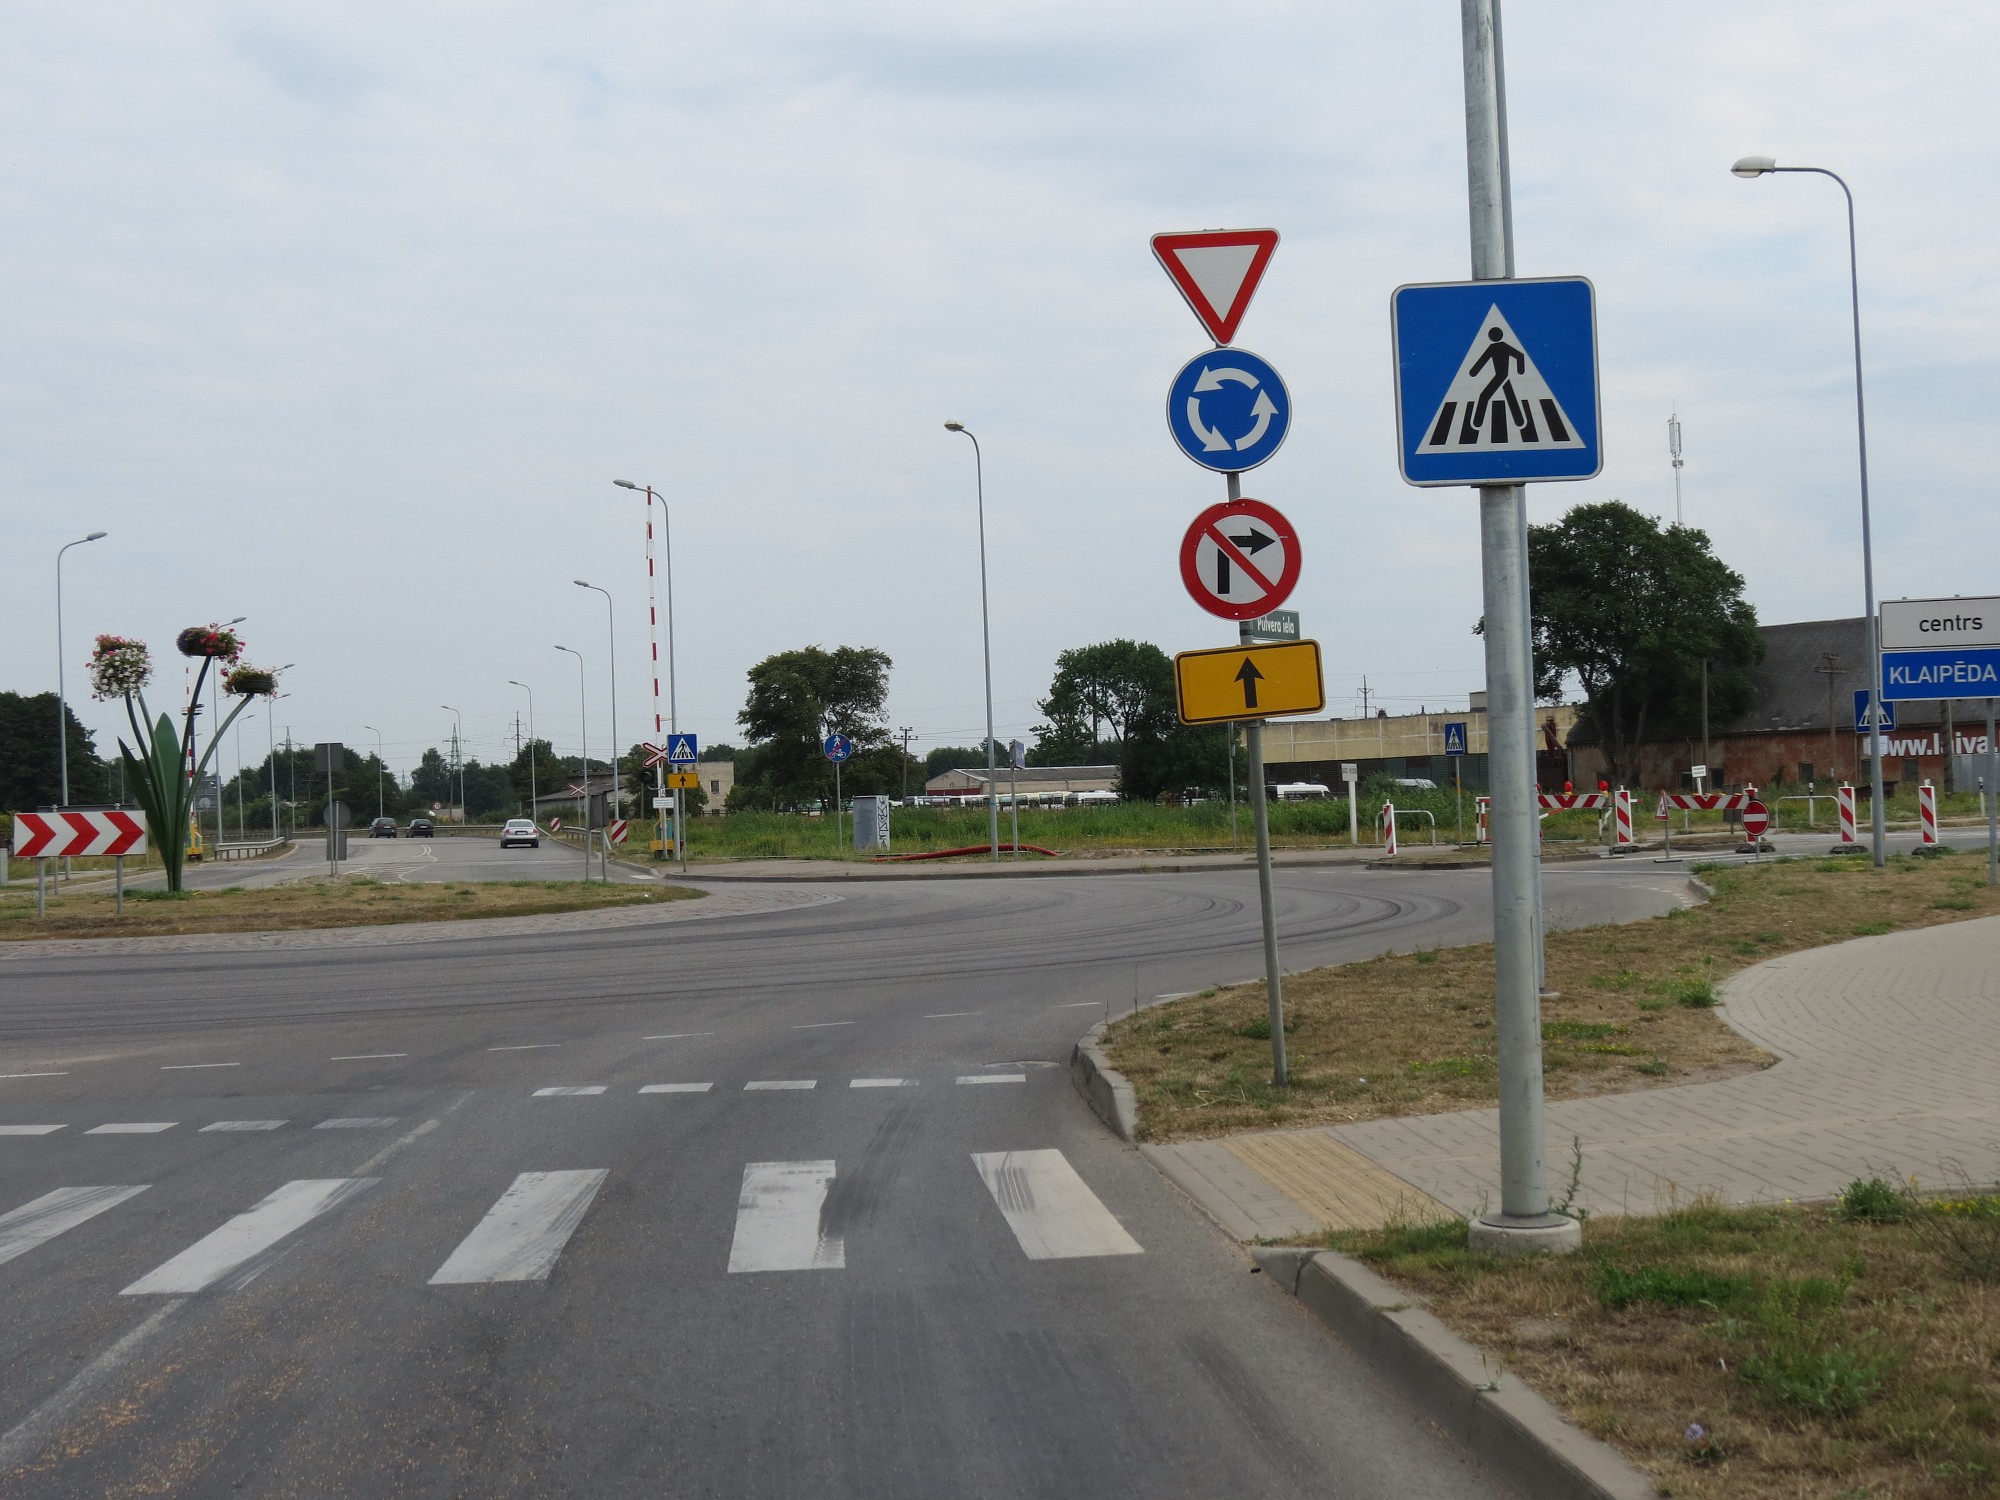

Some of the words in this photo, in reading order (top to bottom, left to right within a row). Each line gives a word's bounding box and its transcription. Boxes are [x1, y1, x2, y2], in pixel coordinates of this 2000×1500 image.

[1282, 616, 1294, 634] iela
[1919, 615, 1983, 632] centrs
[1890, 661, 1997, 685] KLAIPĒDA
